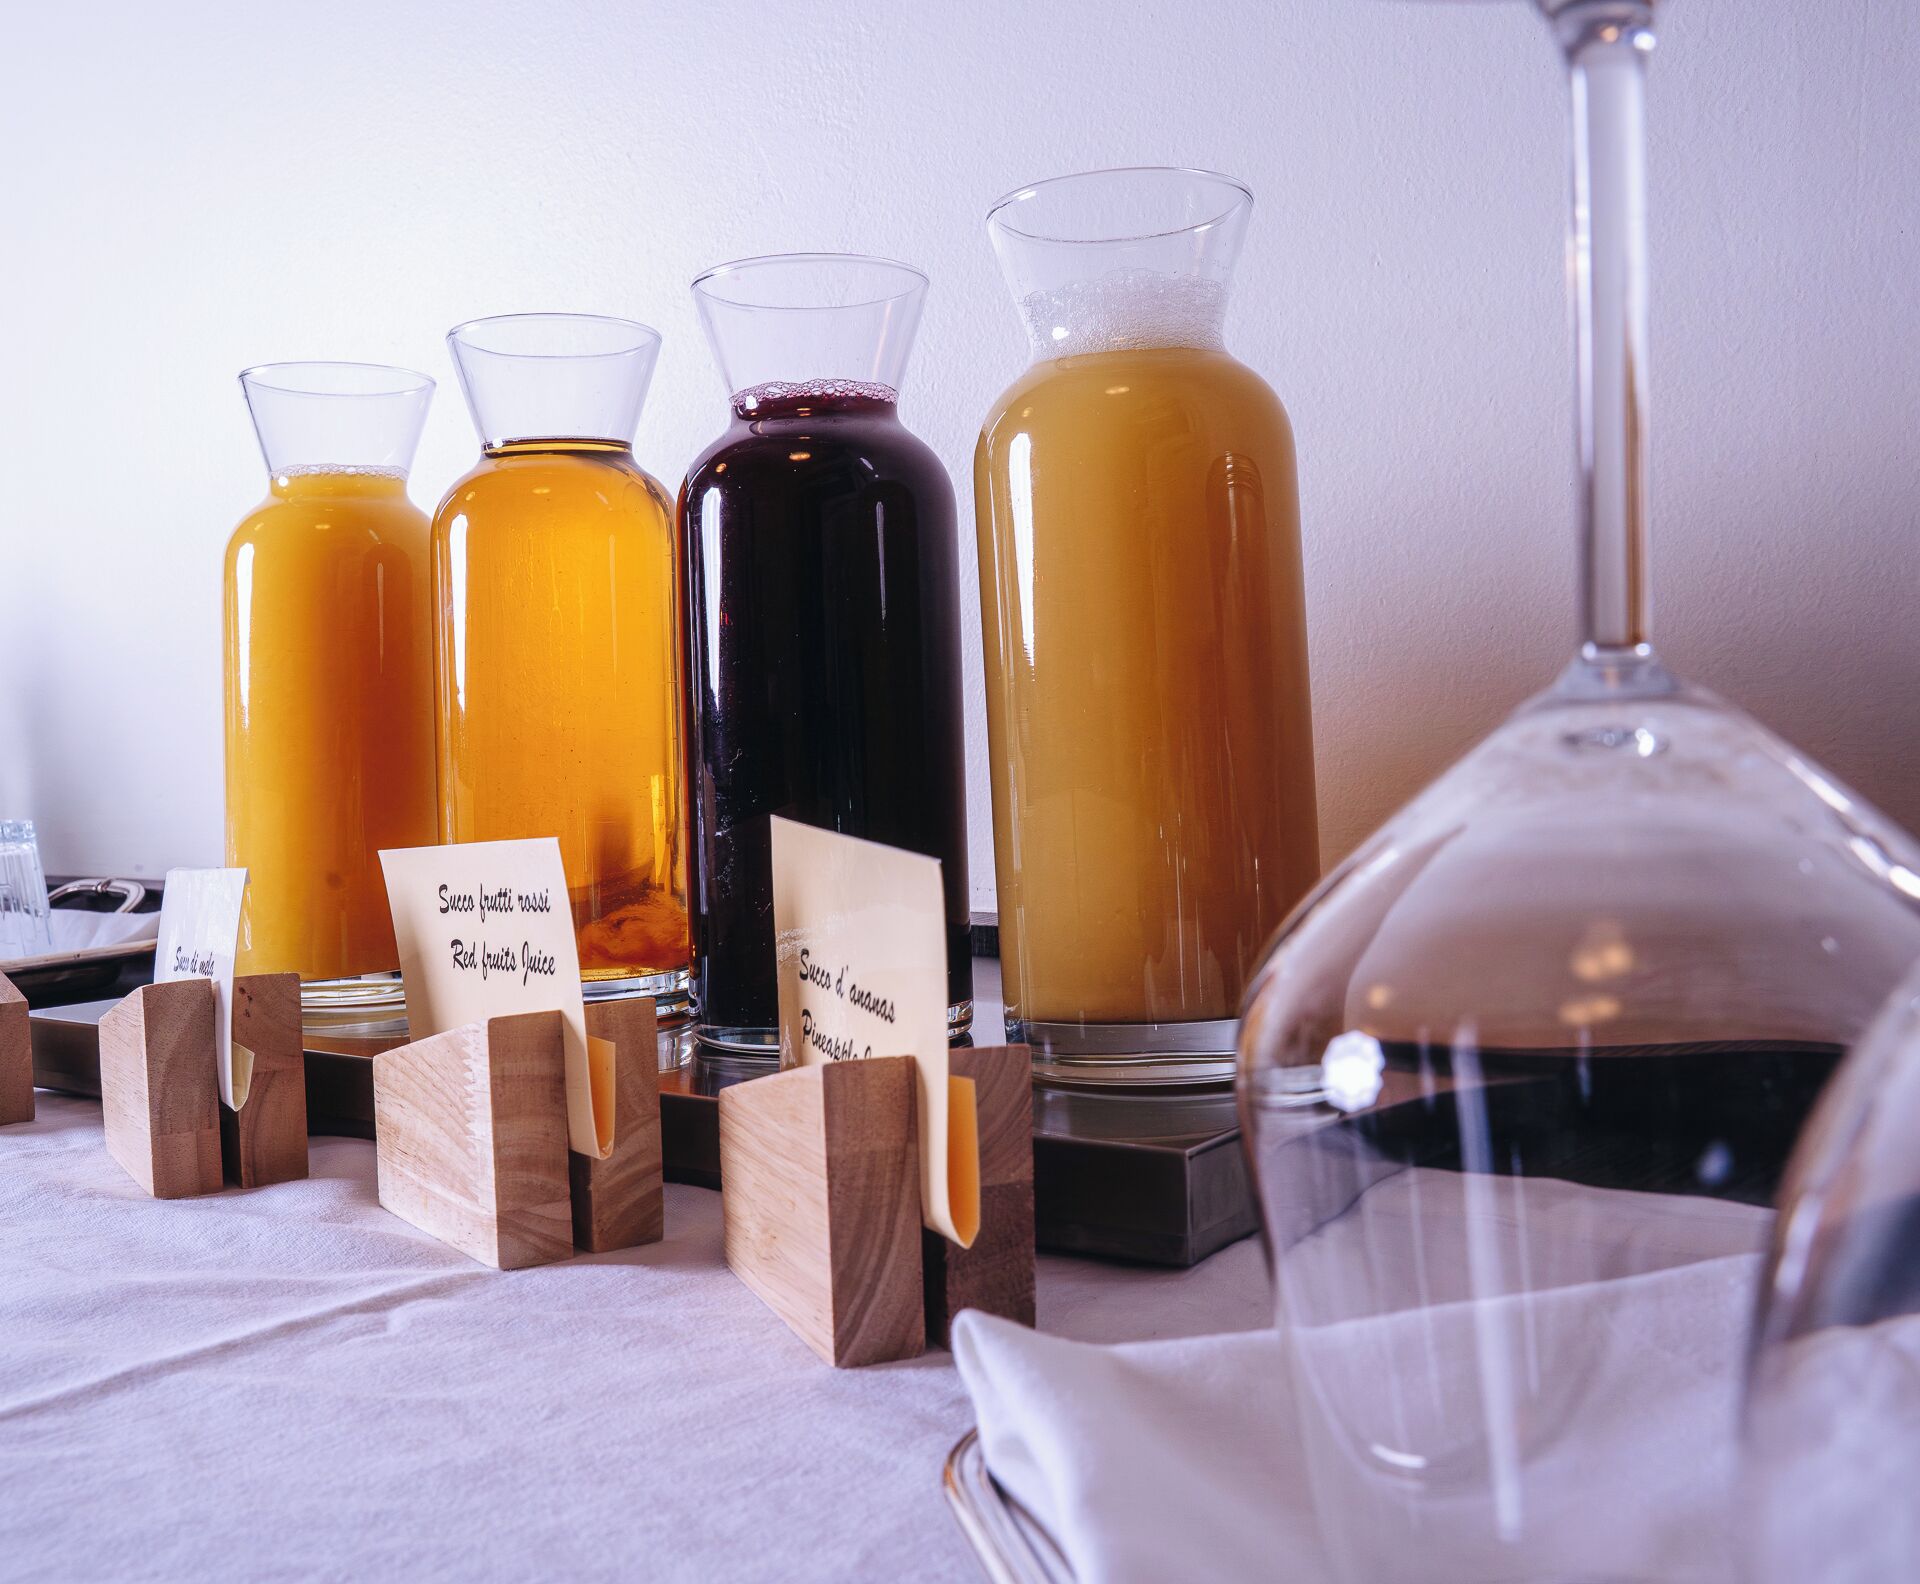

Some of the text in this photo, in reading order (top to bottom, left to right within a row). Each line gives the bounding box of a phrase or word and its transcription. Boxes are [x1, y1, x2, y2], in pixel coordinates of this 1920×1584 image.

[438, 883, 551, 923] Succo frutti rossi
[450, 939, 556, 987] Red fruits Juice
[799, 948, 832, 990] Succo
